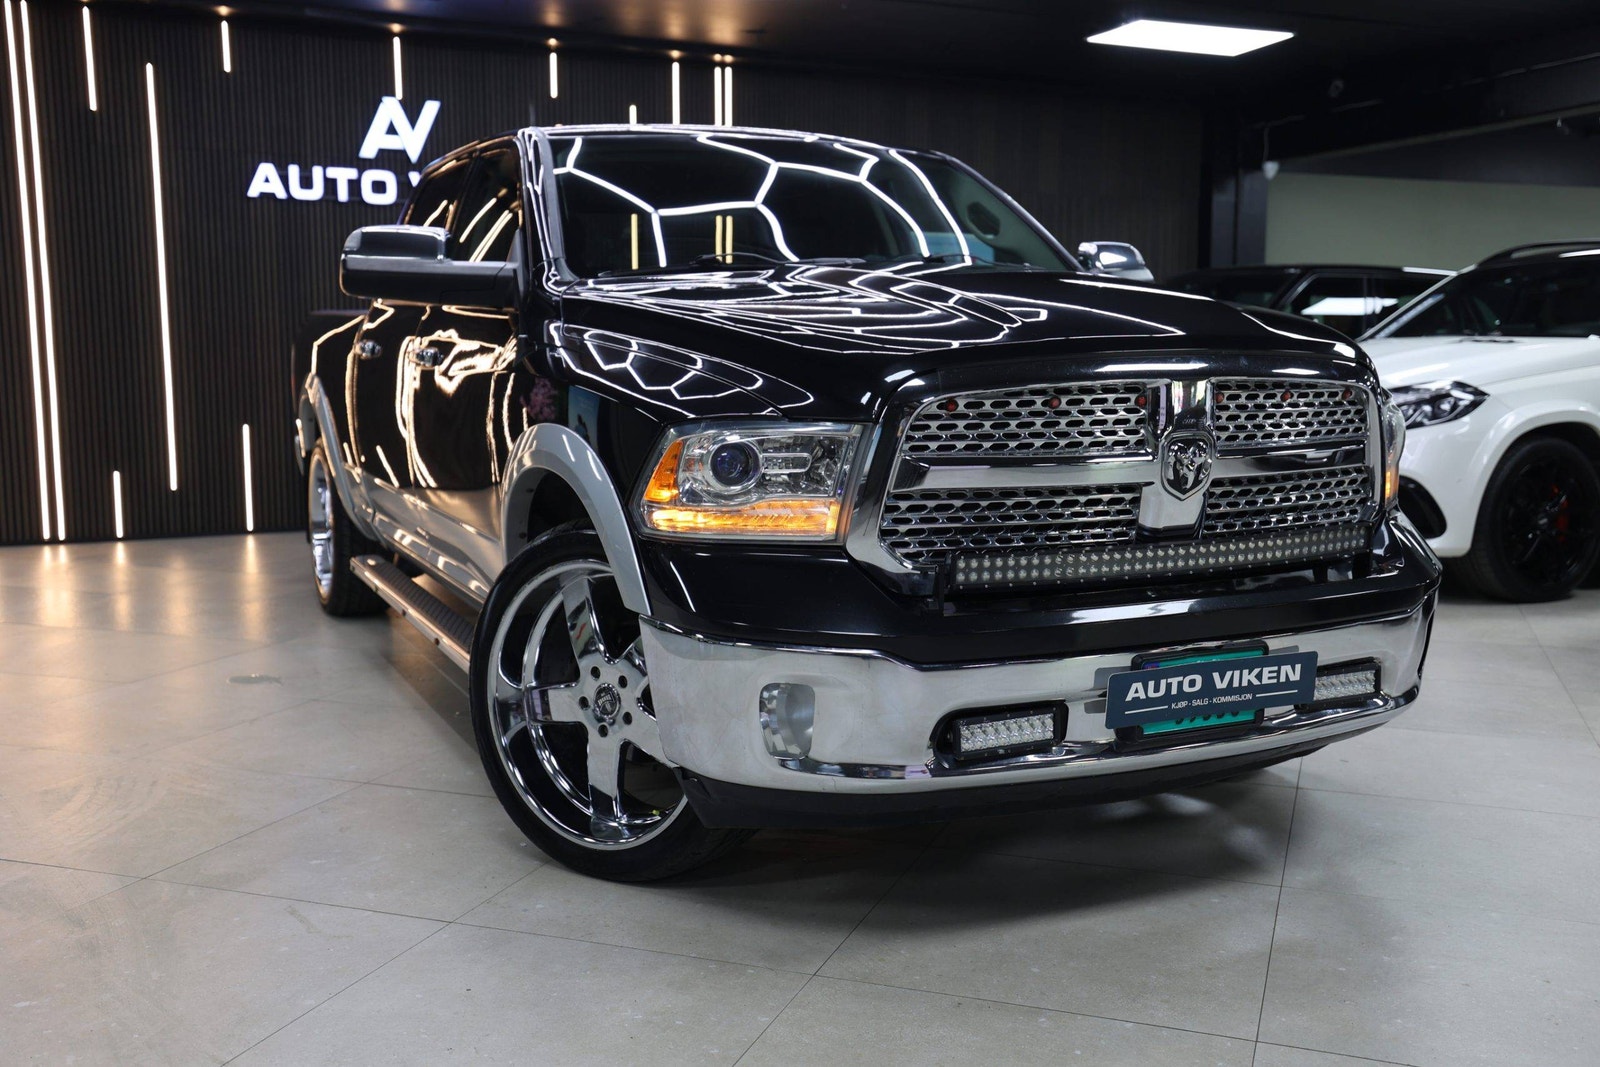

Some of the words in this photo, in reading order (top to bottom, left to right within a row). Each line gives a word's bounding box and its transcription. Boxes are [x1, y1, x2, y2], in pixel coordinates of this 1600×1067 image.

[358, 95, 441, 165] AV
[246, 162, 398, 206] AUTO
[1125, 674, 1203, 702] AUTO
[1212, 663, 1302, 690] VIKEN
[1171, 700, 1189, 710] KJØP
[1191, 698, 1209, 707] SALG
[1212, 693, 1253, 704] KOMMISJON
